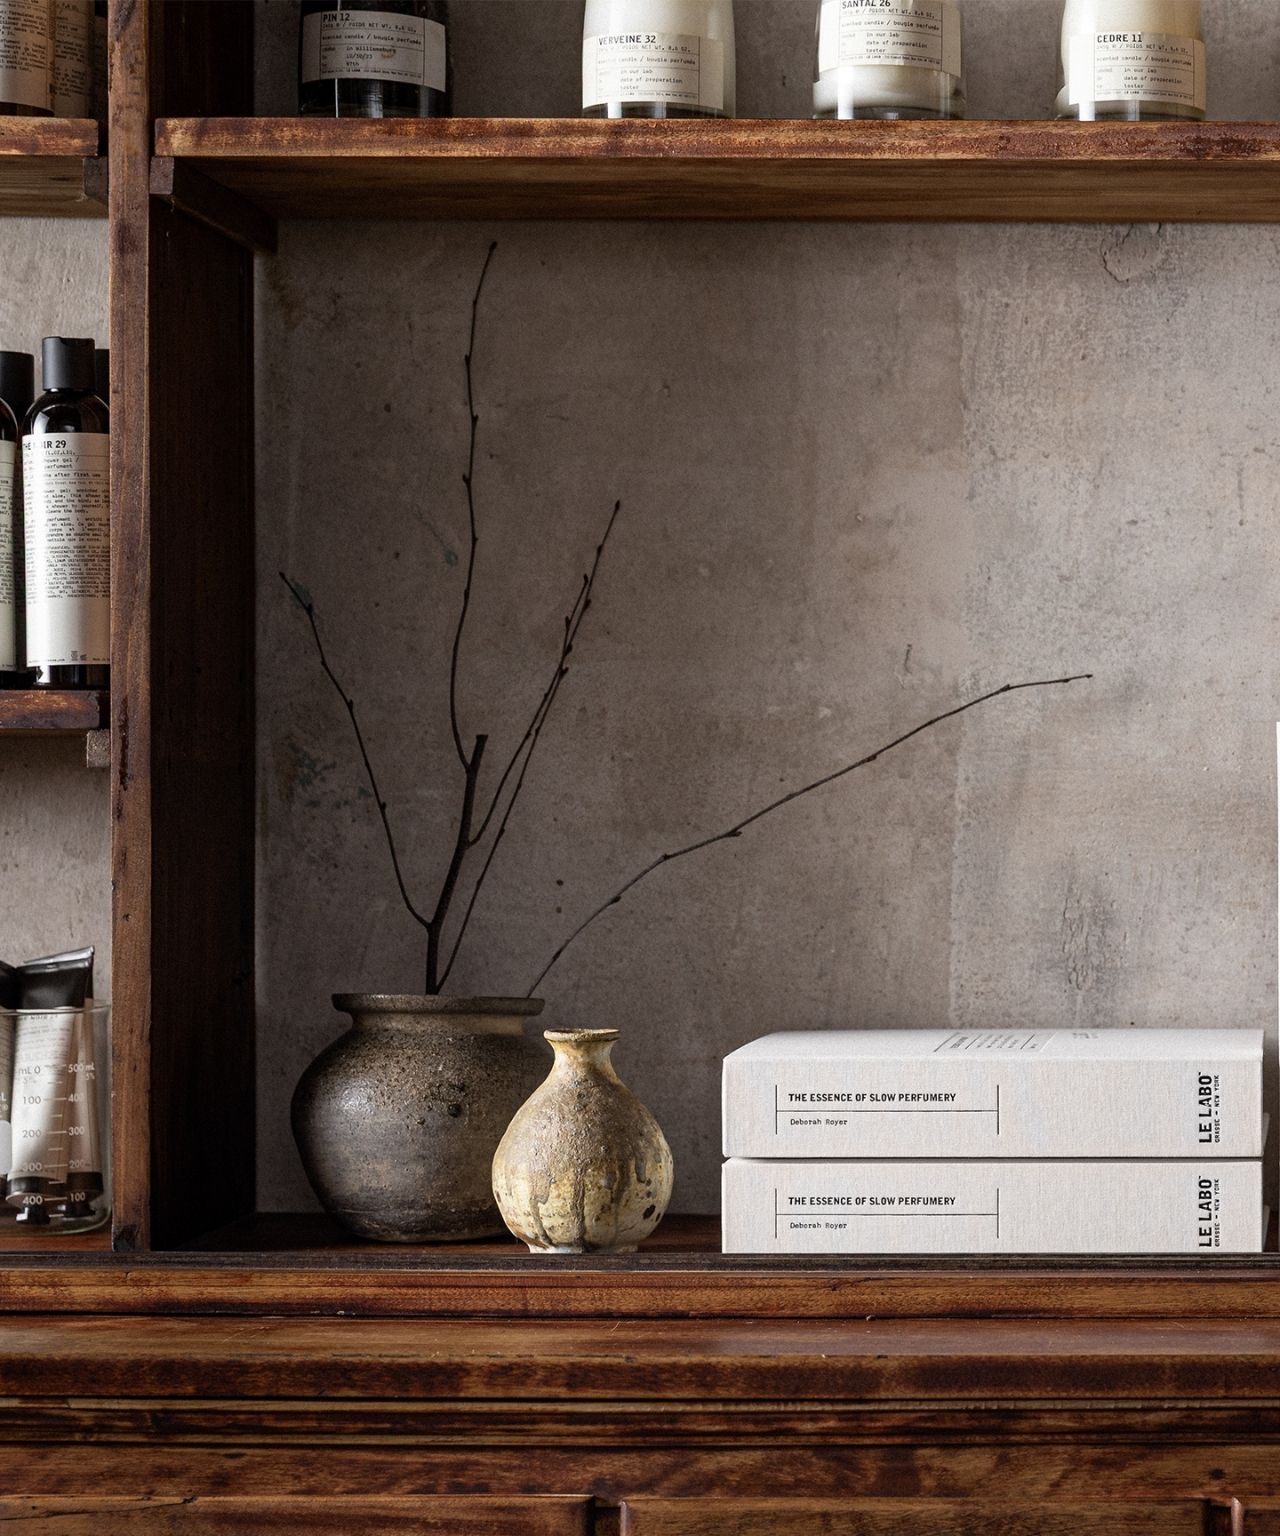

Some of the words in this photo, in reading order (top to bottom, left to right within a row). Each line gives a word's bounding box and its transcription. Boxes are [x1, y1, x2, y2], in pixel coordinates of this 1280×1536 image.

[842, 0, 877, 9] SANTAL
[323, 13, 337, 22] PIN
[340, 13, 351, 21] 12
[598, 35, 641, 46] VERVEINE
[645, 35, 656, 44] 32
[1097, 34, 1128, 43] CEDRE
[1132, 34, 1143, 43] 11
[55, 440, 67, 449] 29
[68, 1063, 84, 1073] 500
[23, 1095, 42, 1105] 100
[788, 1093, 807, 1103] THE
[809, 1093, 853, 1103] ESSENCE
[855, 1093, 867, 1103] OF
[869, 1093, 897, 1103] SLOW
[898, 1093, 956, 1103] PERFUMERY
[790, 1118, 822, 1127] Deborah
[825, 1118, 848, 1127] Royer
[22, 1129, 42, 1139] 200
[68, 1126, 85, 1136] 300
[1199, 1123, 1212, 1143] LE
[22, 1194, 43, 1205] 400
[70, 1192, 86, 1202] 100
[788, 1196, 807, 1206] THE
[809, 1196, 853, 1206] ESSENCE
[855, 1196, 867, 1206] OF
[869, 1196, 897, 1206] SLOW
[898, 1196, 956, 1206] PERFUMERY
[790, 1222, 822, 1230] Deborah
[825, 1222, 848, 1230] Royer
[1199, 1227, 1212, 1247] LE
